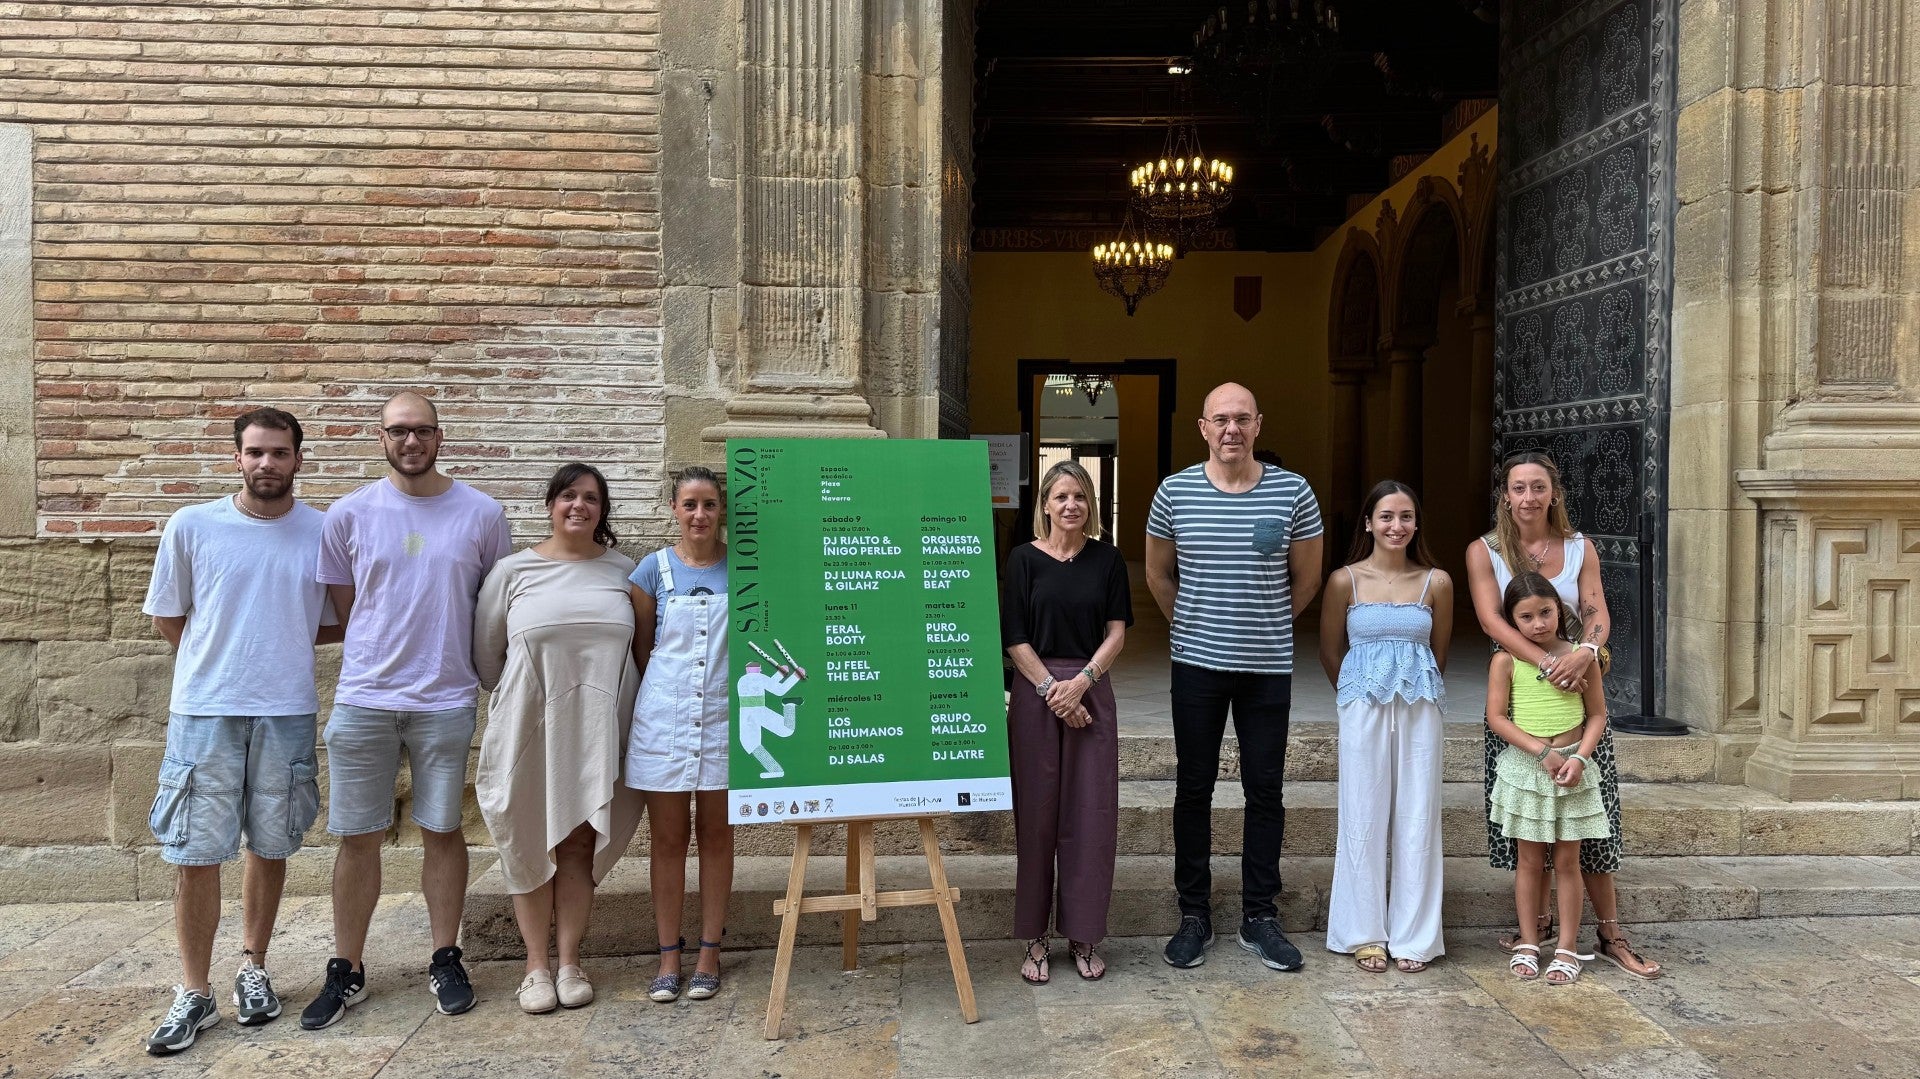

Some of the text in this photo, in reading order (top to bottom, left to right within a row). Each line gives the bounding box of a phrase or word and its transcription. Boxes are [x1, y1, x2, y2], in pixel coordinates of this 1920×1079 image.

[735, 448, 760, 632] SAN LORENZO
[824, 536, 891, 545] DJ RIALTO &
[922, 536, 980, 544] ORQUESTA
[824, 545, 901, 556] ÍNIGO PERLED
[922, 543, 981, 554] MAÑAMBO
[825, 570, 905, 580] DJ LUNA ROJA
[924, 570, 970, 578] DJ GATO
[825, 581, 879, 590] & GILAHZ
[924, 581, 950, 589] BEAT
[826, 625, 861, 634] FERAL
[926, 623, 956, 632] PURO
[826, 636, 865, 645] BOOTY
[927, 633, 969, 642] RELAJO
[827, 661, 870, 670] DJ FEEL
[928, 656, 973, 668] DJ ÁLEX
[827, 671, 880, 681] THE BEAT
[929, 669, 967, 678] SOUSA
[828, 694, 871, 703] miércoles
[930, 692, 957, 701] jueves
[829, 717, 850, 727] LOS
[931, 713, 971, 723] GRUPO
[829, 727, 903, 738] INHUMANOS
[932, 724, 986, 734] MALLAZO
[830, 754, 884, 765] DJ SALAS
[933, 750, 984, 760] DJ LATRE
